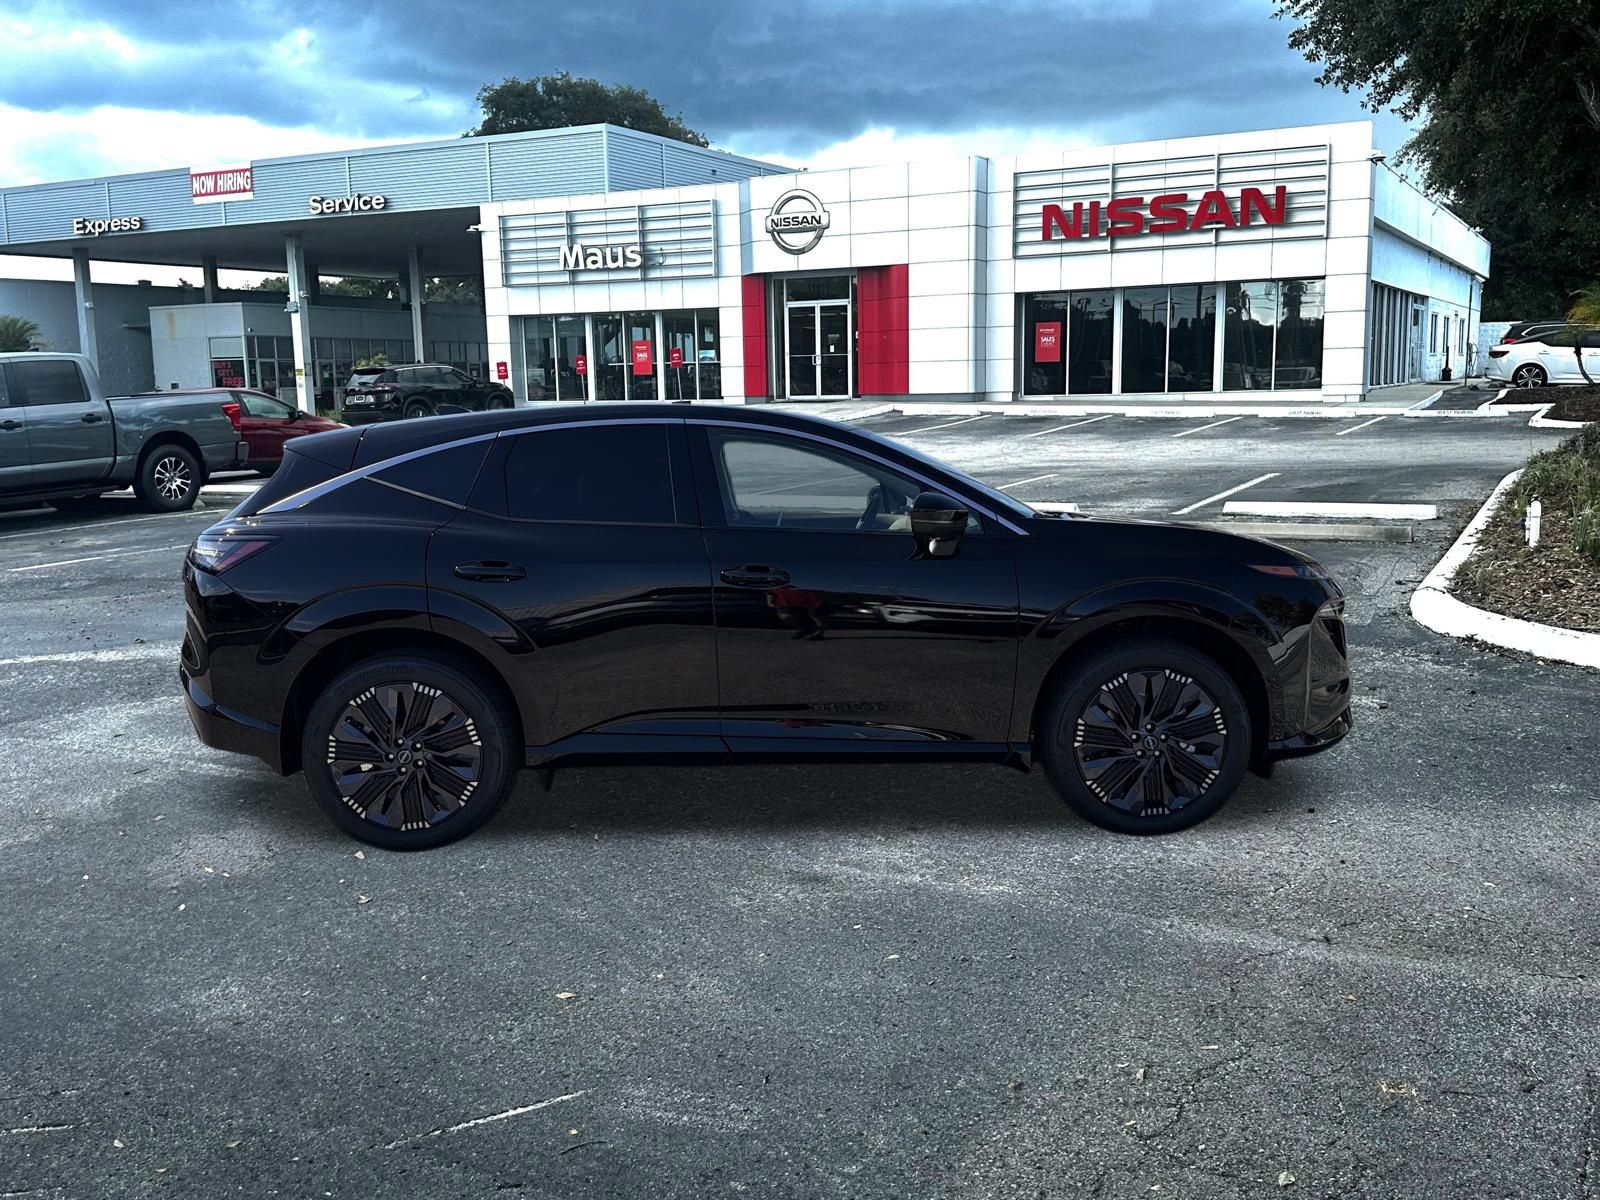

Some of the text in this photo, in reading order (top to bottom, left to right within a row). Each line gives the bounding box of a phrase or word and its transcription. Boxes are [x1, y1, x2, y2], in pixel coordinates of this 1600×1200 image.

[192, 171, 251, 195] NOW HIRING
[309, 193, 385, 214] Service
[1042, 185, 1287, 241] NISSAN
[73, 216, 141, 237] Express
[770, 214, 822, 228] NISSAN
[559, 243, 641, 270] Maus
[223, 377, 243, 386] FREE
